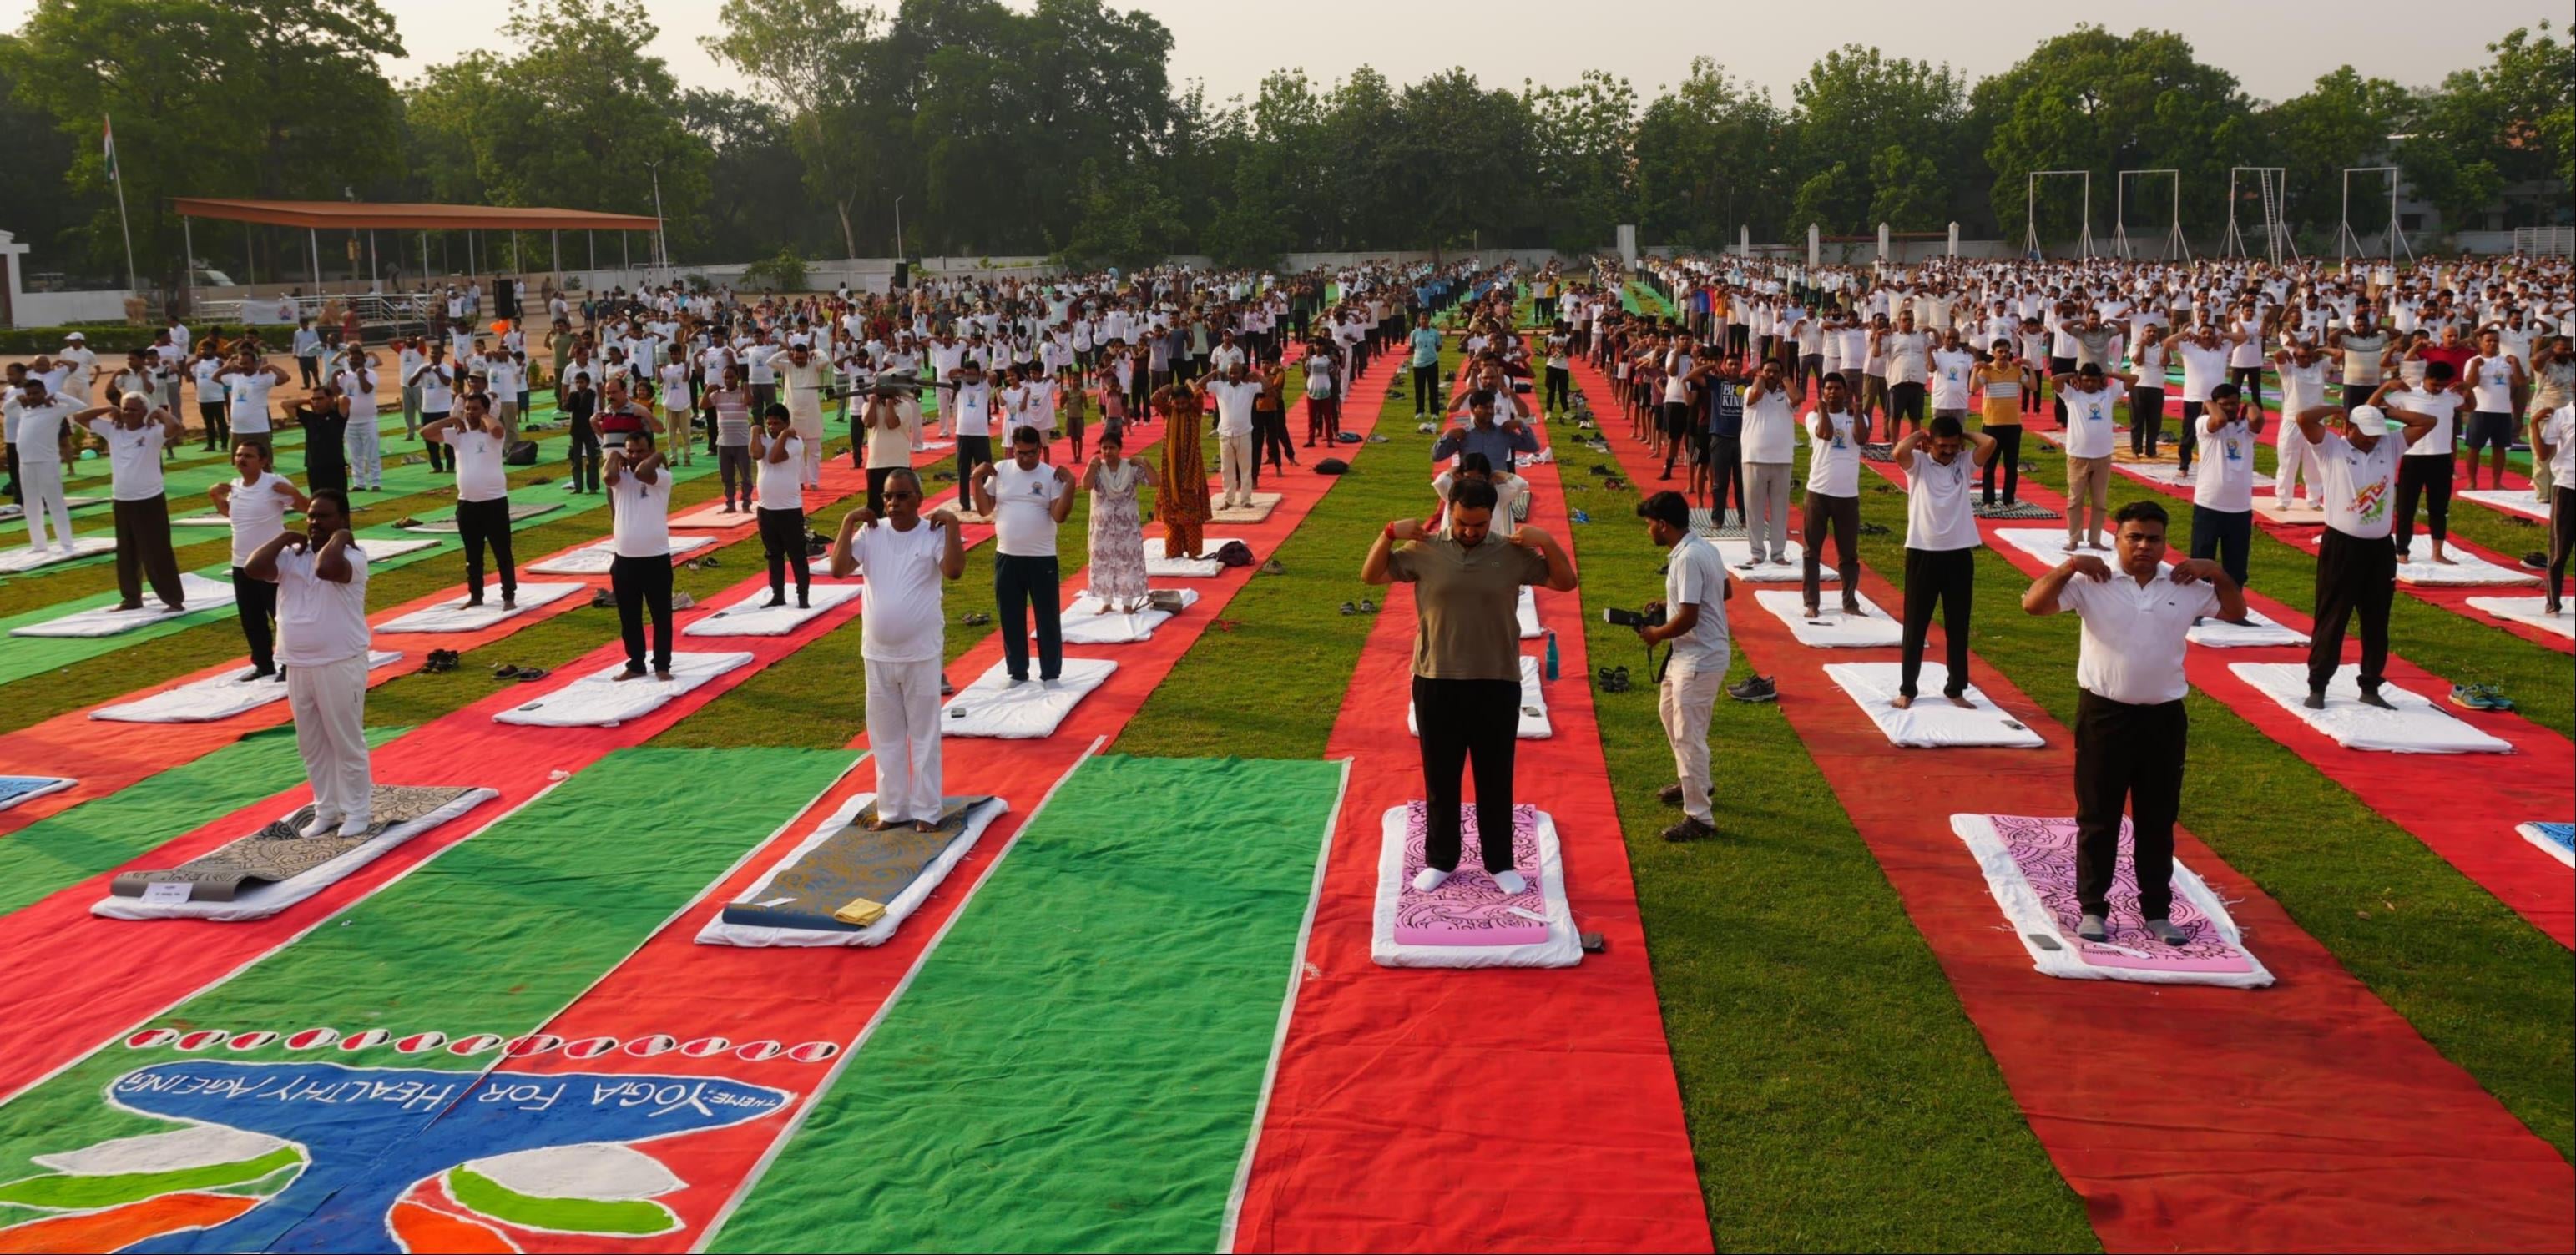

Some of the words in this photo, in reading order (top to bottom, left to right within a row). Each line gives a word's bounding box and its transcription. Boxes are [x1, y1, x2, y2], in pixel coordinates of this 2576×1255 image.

[120, 1072, 277, 1099] AGEING
[256, 1075, 456, 1111] HEALTHY
[478, 1082, 567, 1111] FOR
[591, 1082, 714, 1117] YOGA
[707, 1088, 778, 1107] THEME:
